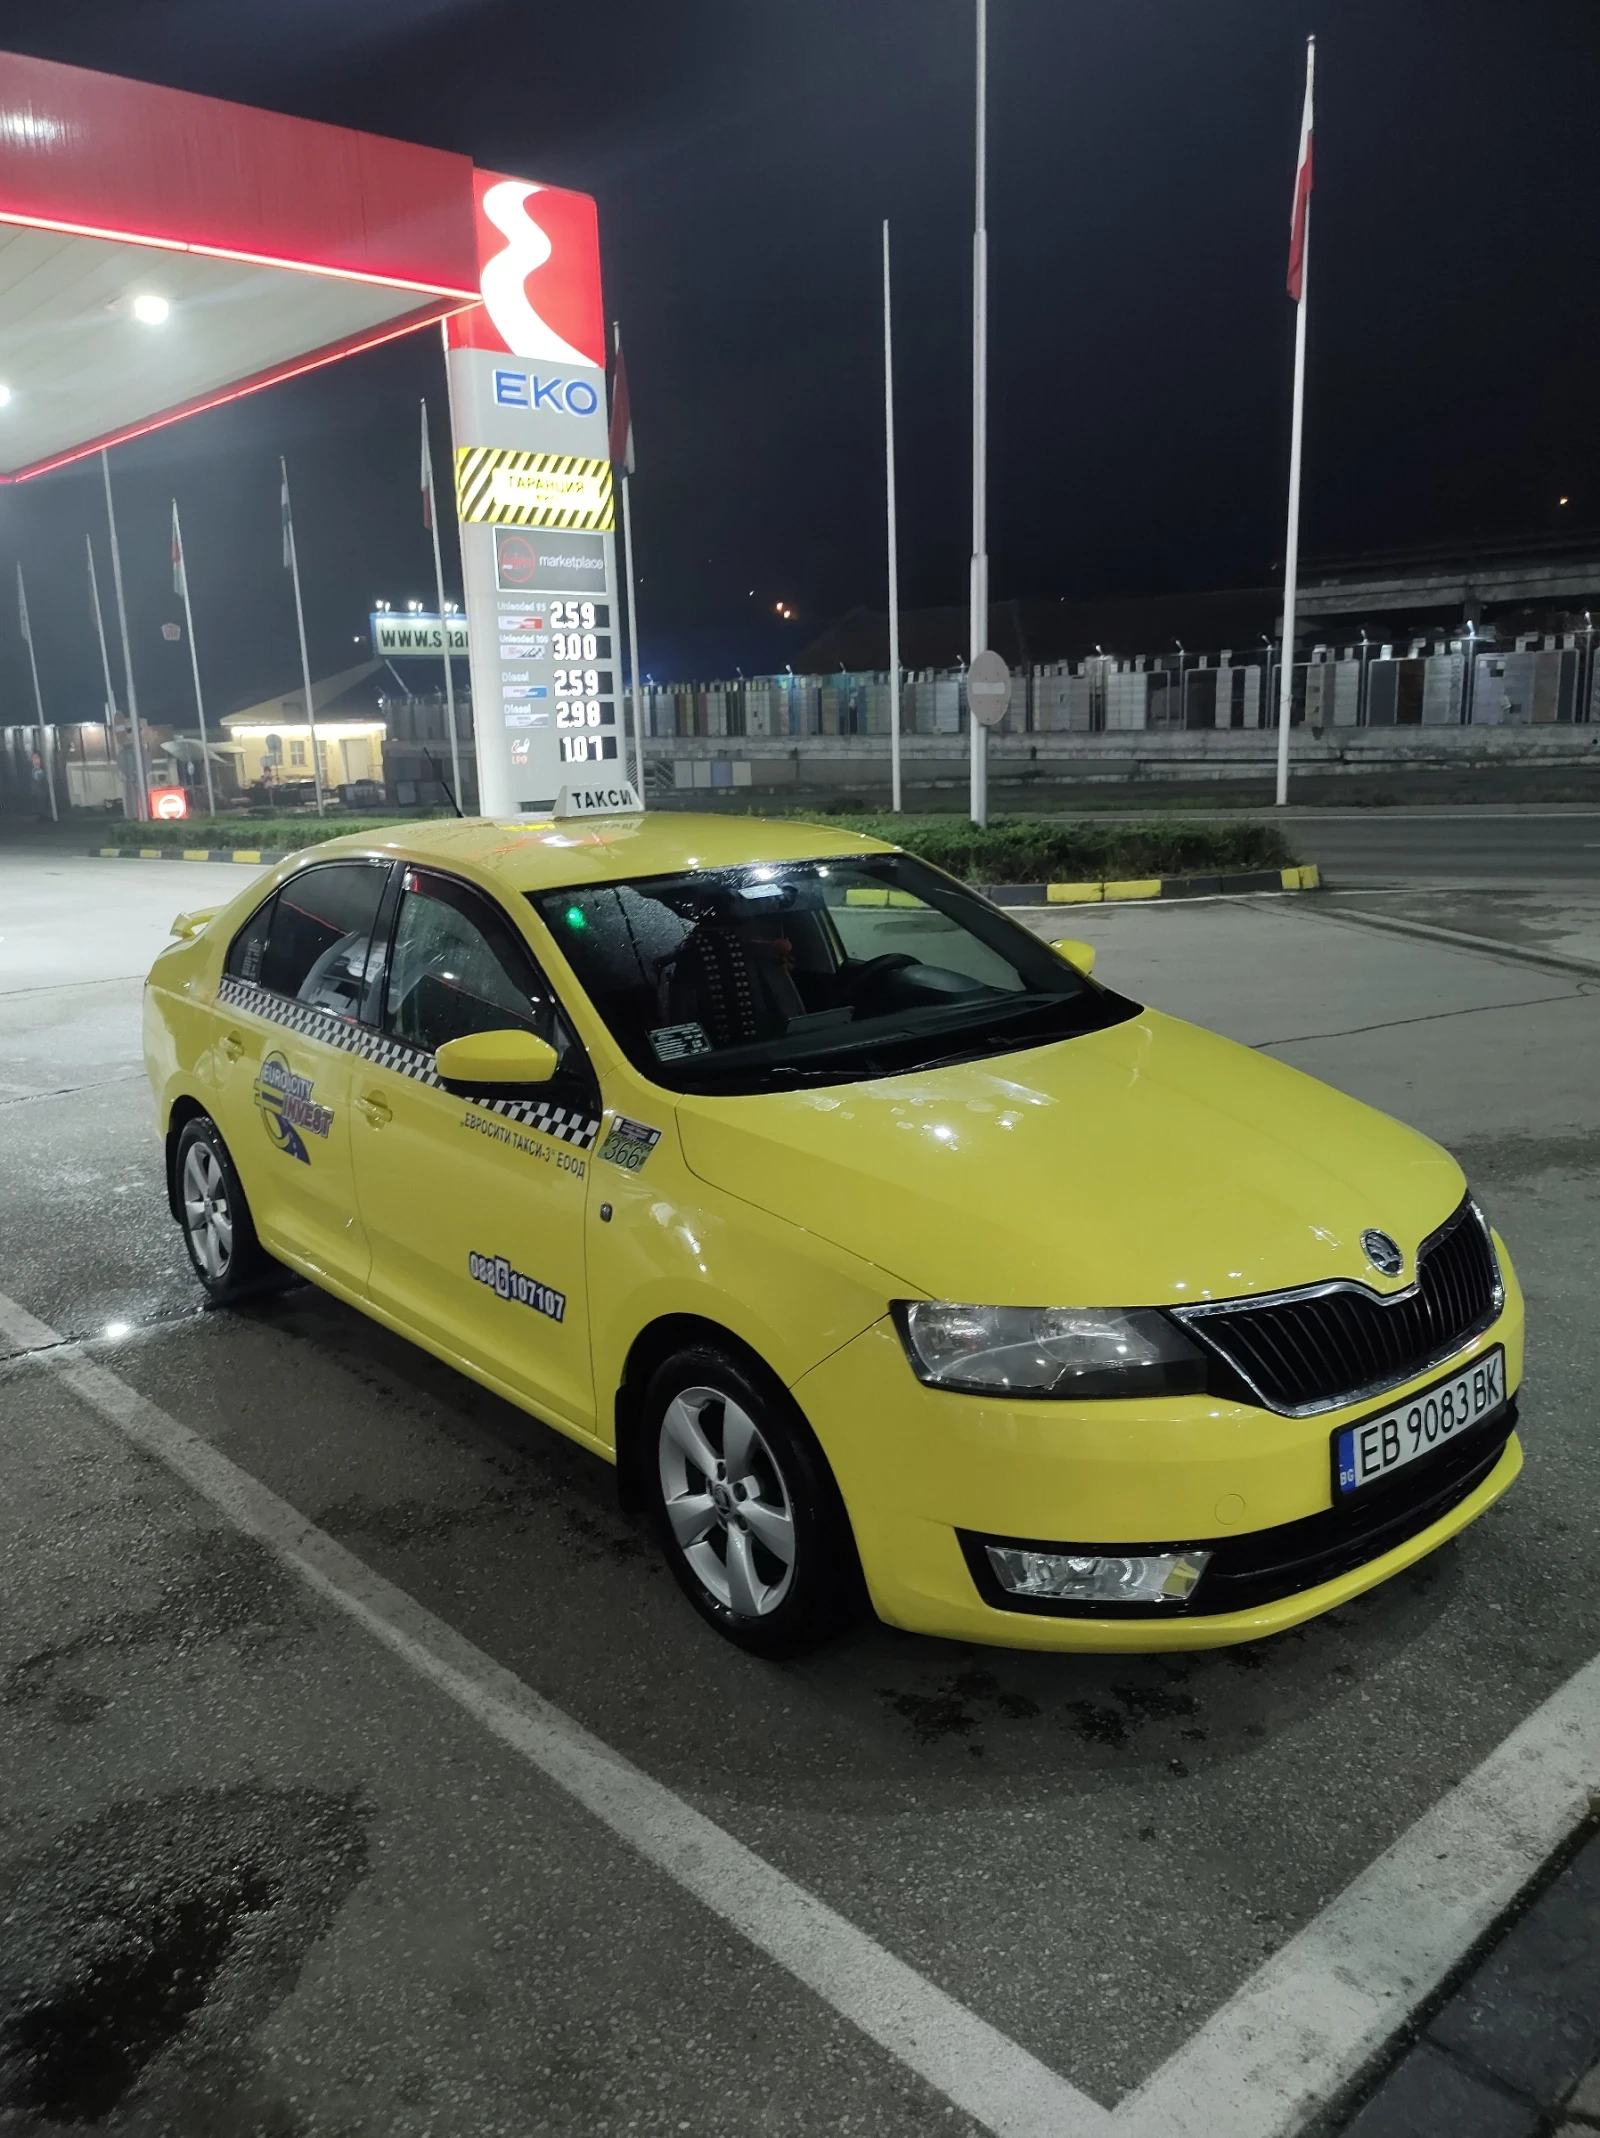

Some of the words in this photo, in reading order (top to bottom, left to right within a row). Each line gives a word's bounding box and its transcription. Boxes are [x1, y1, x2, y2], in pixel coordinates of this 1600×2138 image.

[493, 369, 598, 417] EKO
[508, 475, 585, 494] ГАРАНЦИЯ
[539, 554, 604, 571] marketplace
[497, 601, 535, 611] Unleaded
[536, 602, 547, 612] 95
[499, 634, 535, 644] Unleaded
[502, 671, 530, 682] Diesel
[504, 703, 531, 714] Diesel
[572, 790, 633, 808] ТАКСИ
[263, 1063, 288, 1090] EURO
[290, 1075, 314, 1101] CITY
[282, 1092, 335, 1139] INVEST
[604, 1137, 644, 1169] 366
[556, 1152, 586, 1181] ЕООД
[1361, 1418, 1400, 1477] EB
[1407, 1381, 1469, 1454] 9083
[1474, 1358, 1499, 1415] BK
[1340, 1468, 1354, 1486] BG
